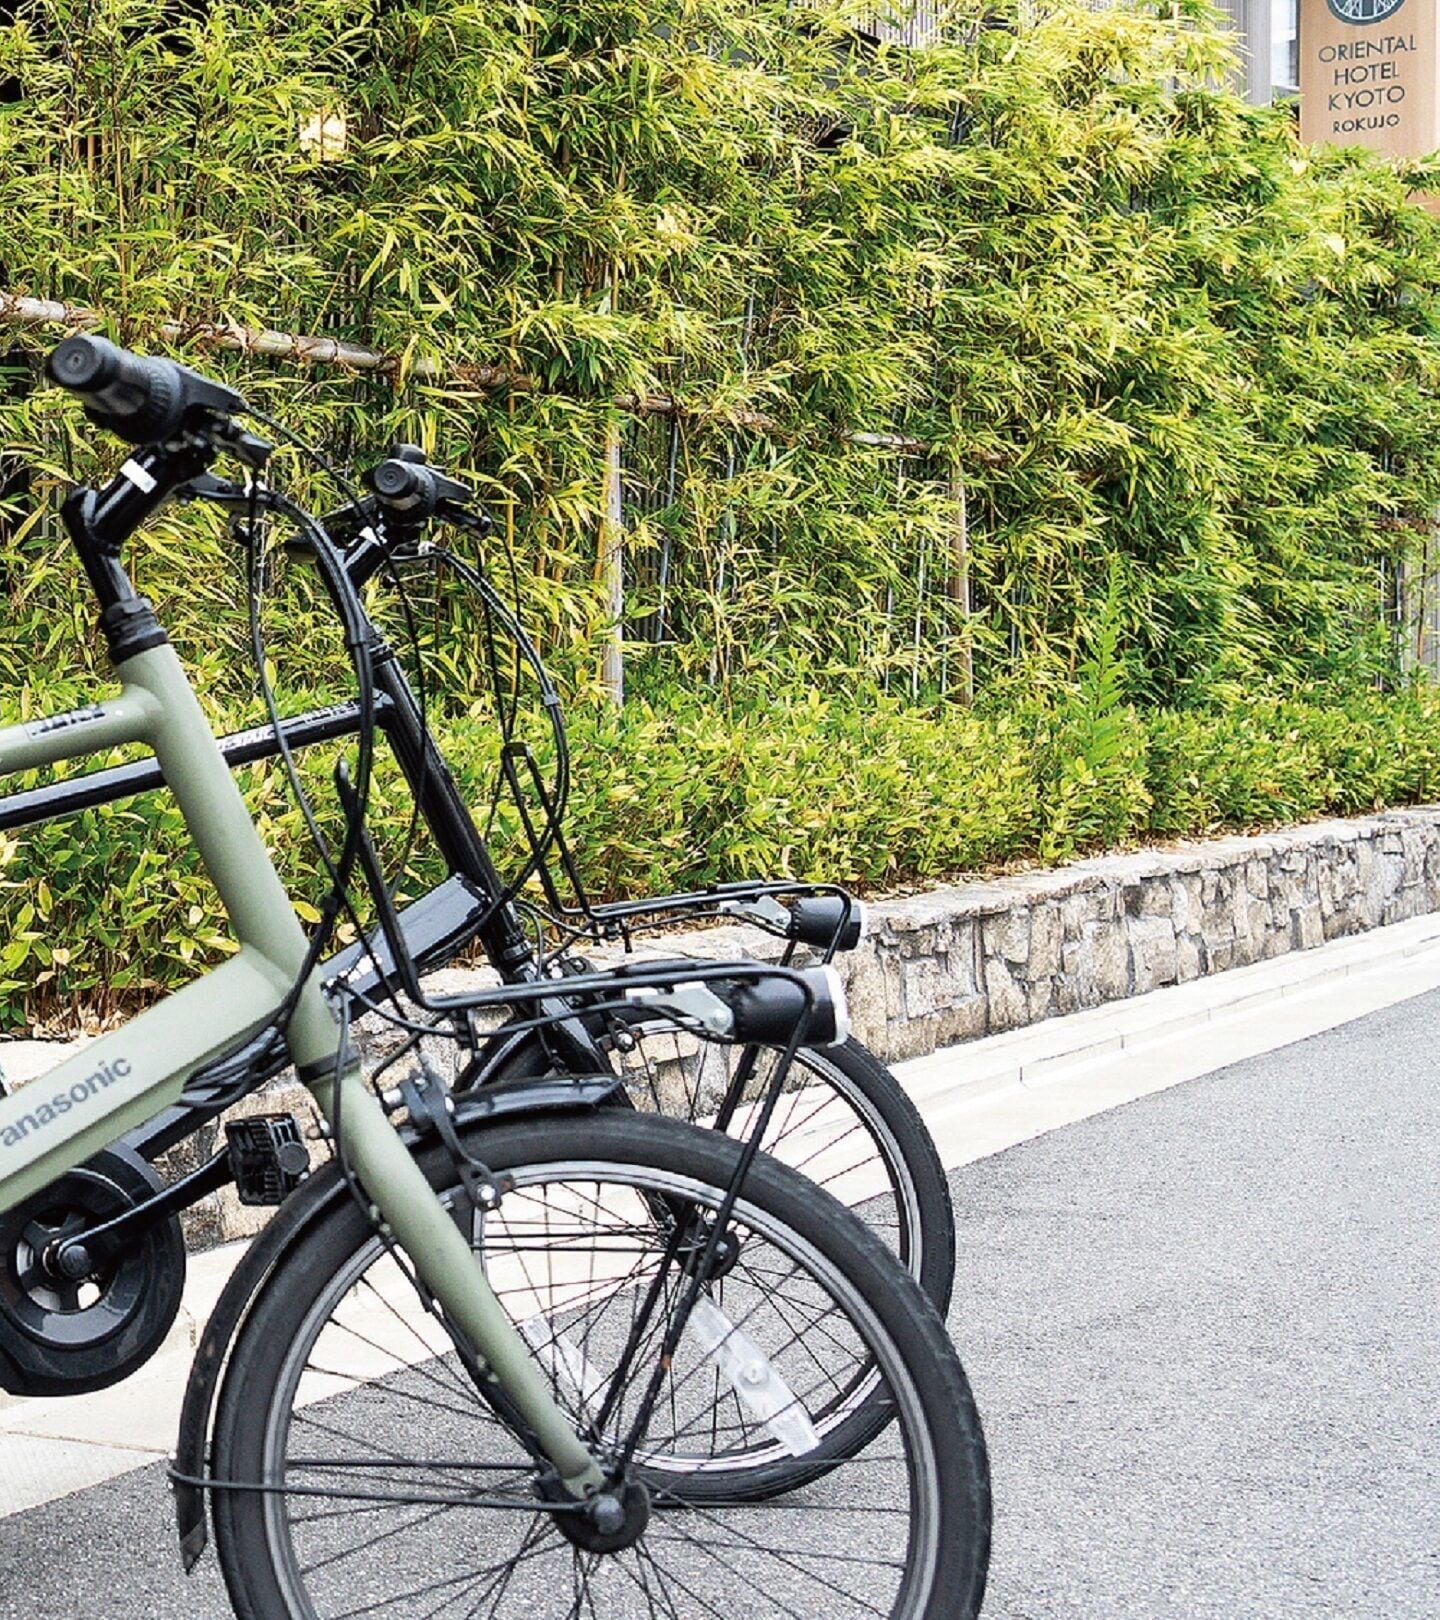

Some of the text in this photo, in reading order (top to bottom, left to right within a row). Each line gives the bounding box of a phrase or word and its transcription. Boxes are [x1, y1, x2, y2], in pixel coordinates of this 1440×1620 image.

[1318, 34, 1417, 63] ORIENTAL
[1334, 61, 1400, 86] HOTEL
[1328, 85, 1405, 111] KYOTO
[1332, 114, 1401, 134] ROKUJO
